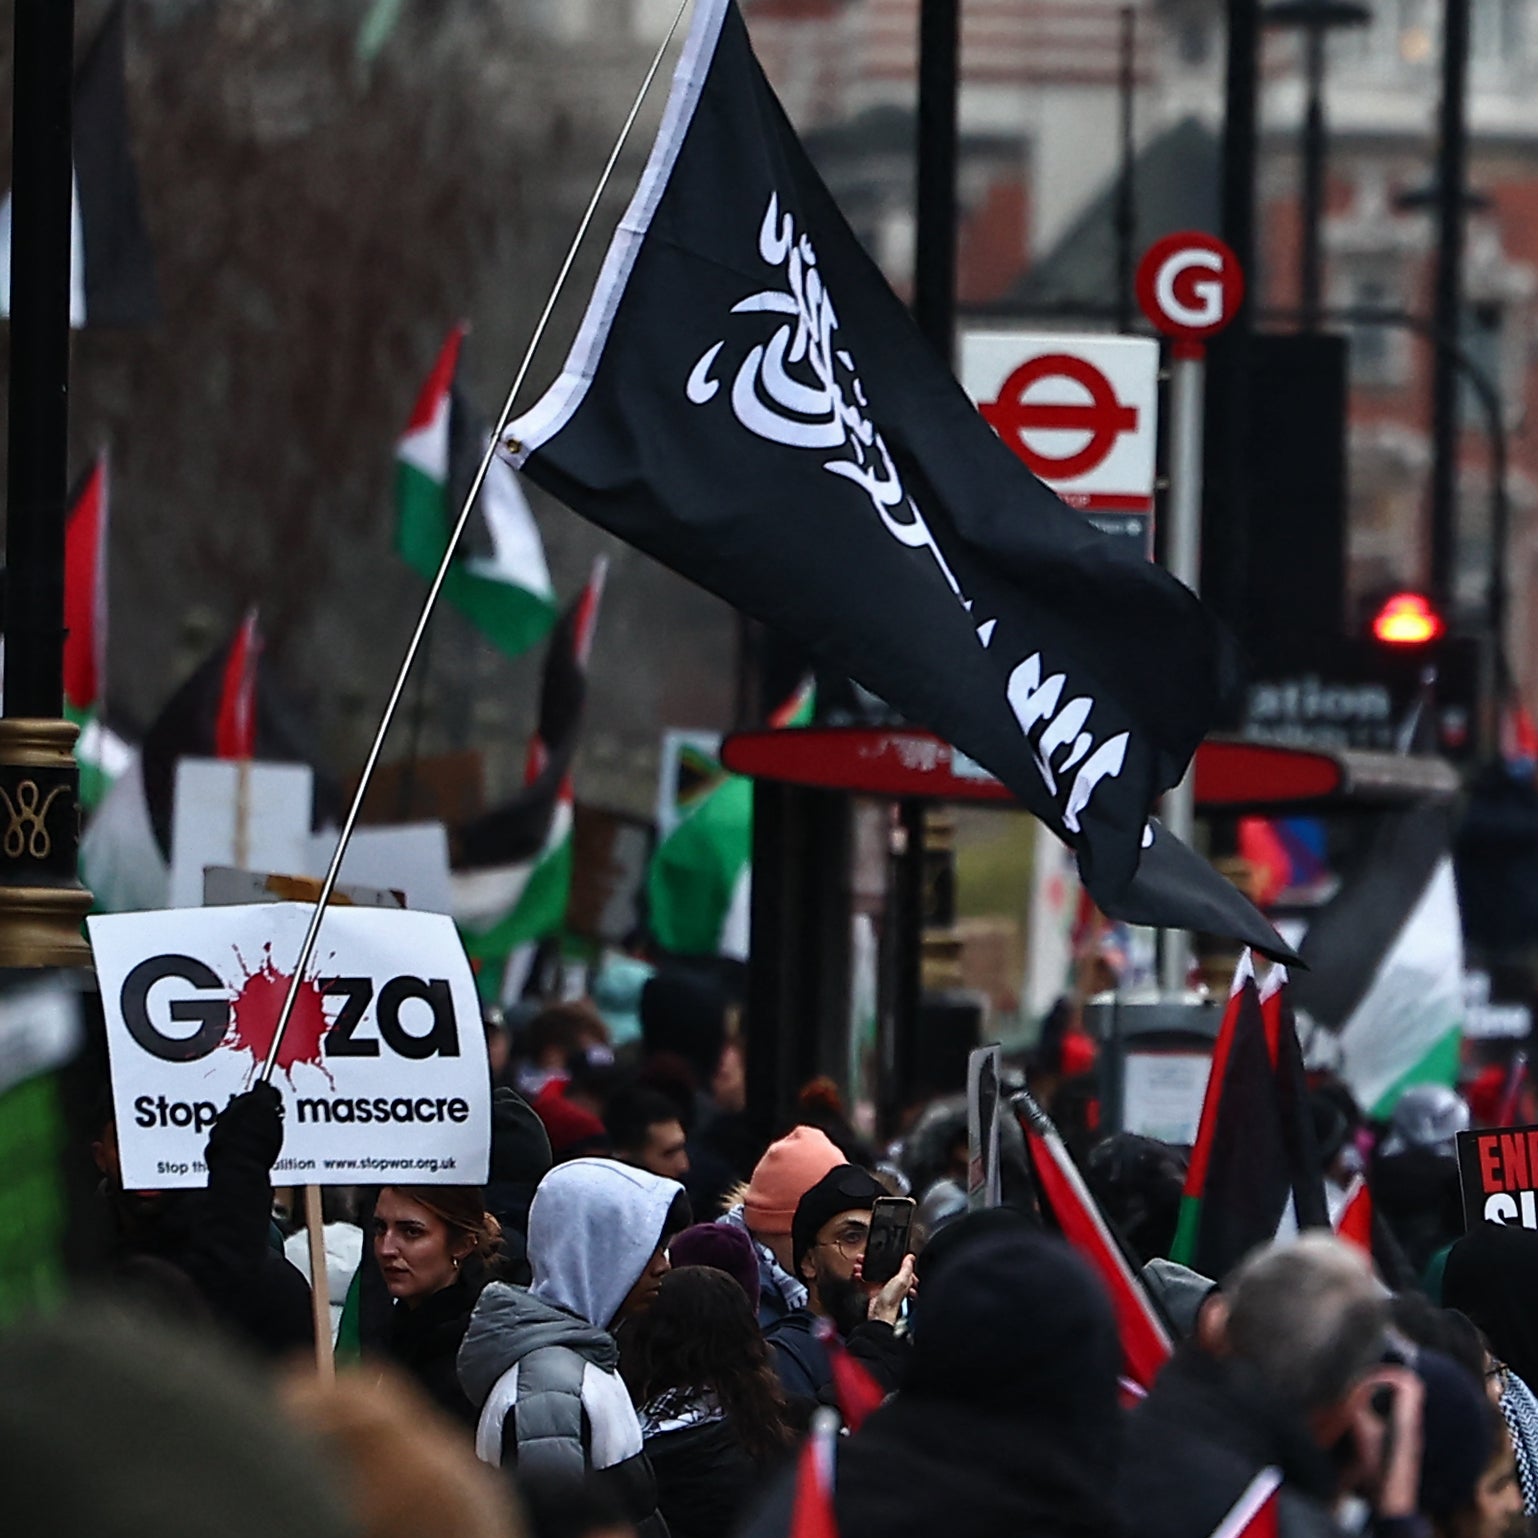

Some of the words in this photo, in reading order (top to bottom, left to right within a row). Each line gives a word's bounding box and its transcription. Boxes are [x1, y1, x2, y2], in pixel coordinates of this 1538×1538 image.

[1156, 249, 1223, 327] G
[134, 1095, 218, 1134] Stop
[297, 1097, 470, 1124] massacre
[157, 1160, 189, 1175] Stop
[191, 1160, 210, 1173] th
[323, 1157, 457, 1172] www.stopwar.org.uk
